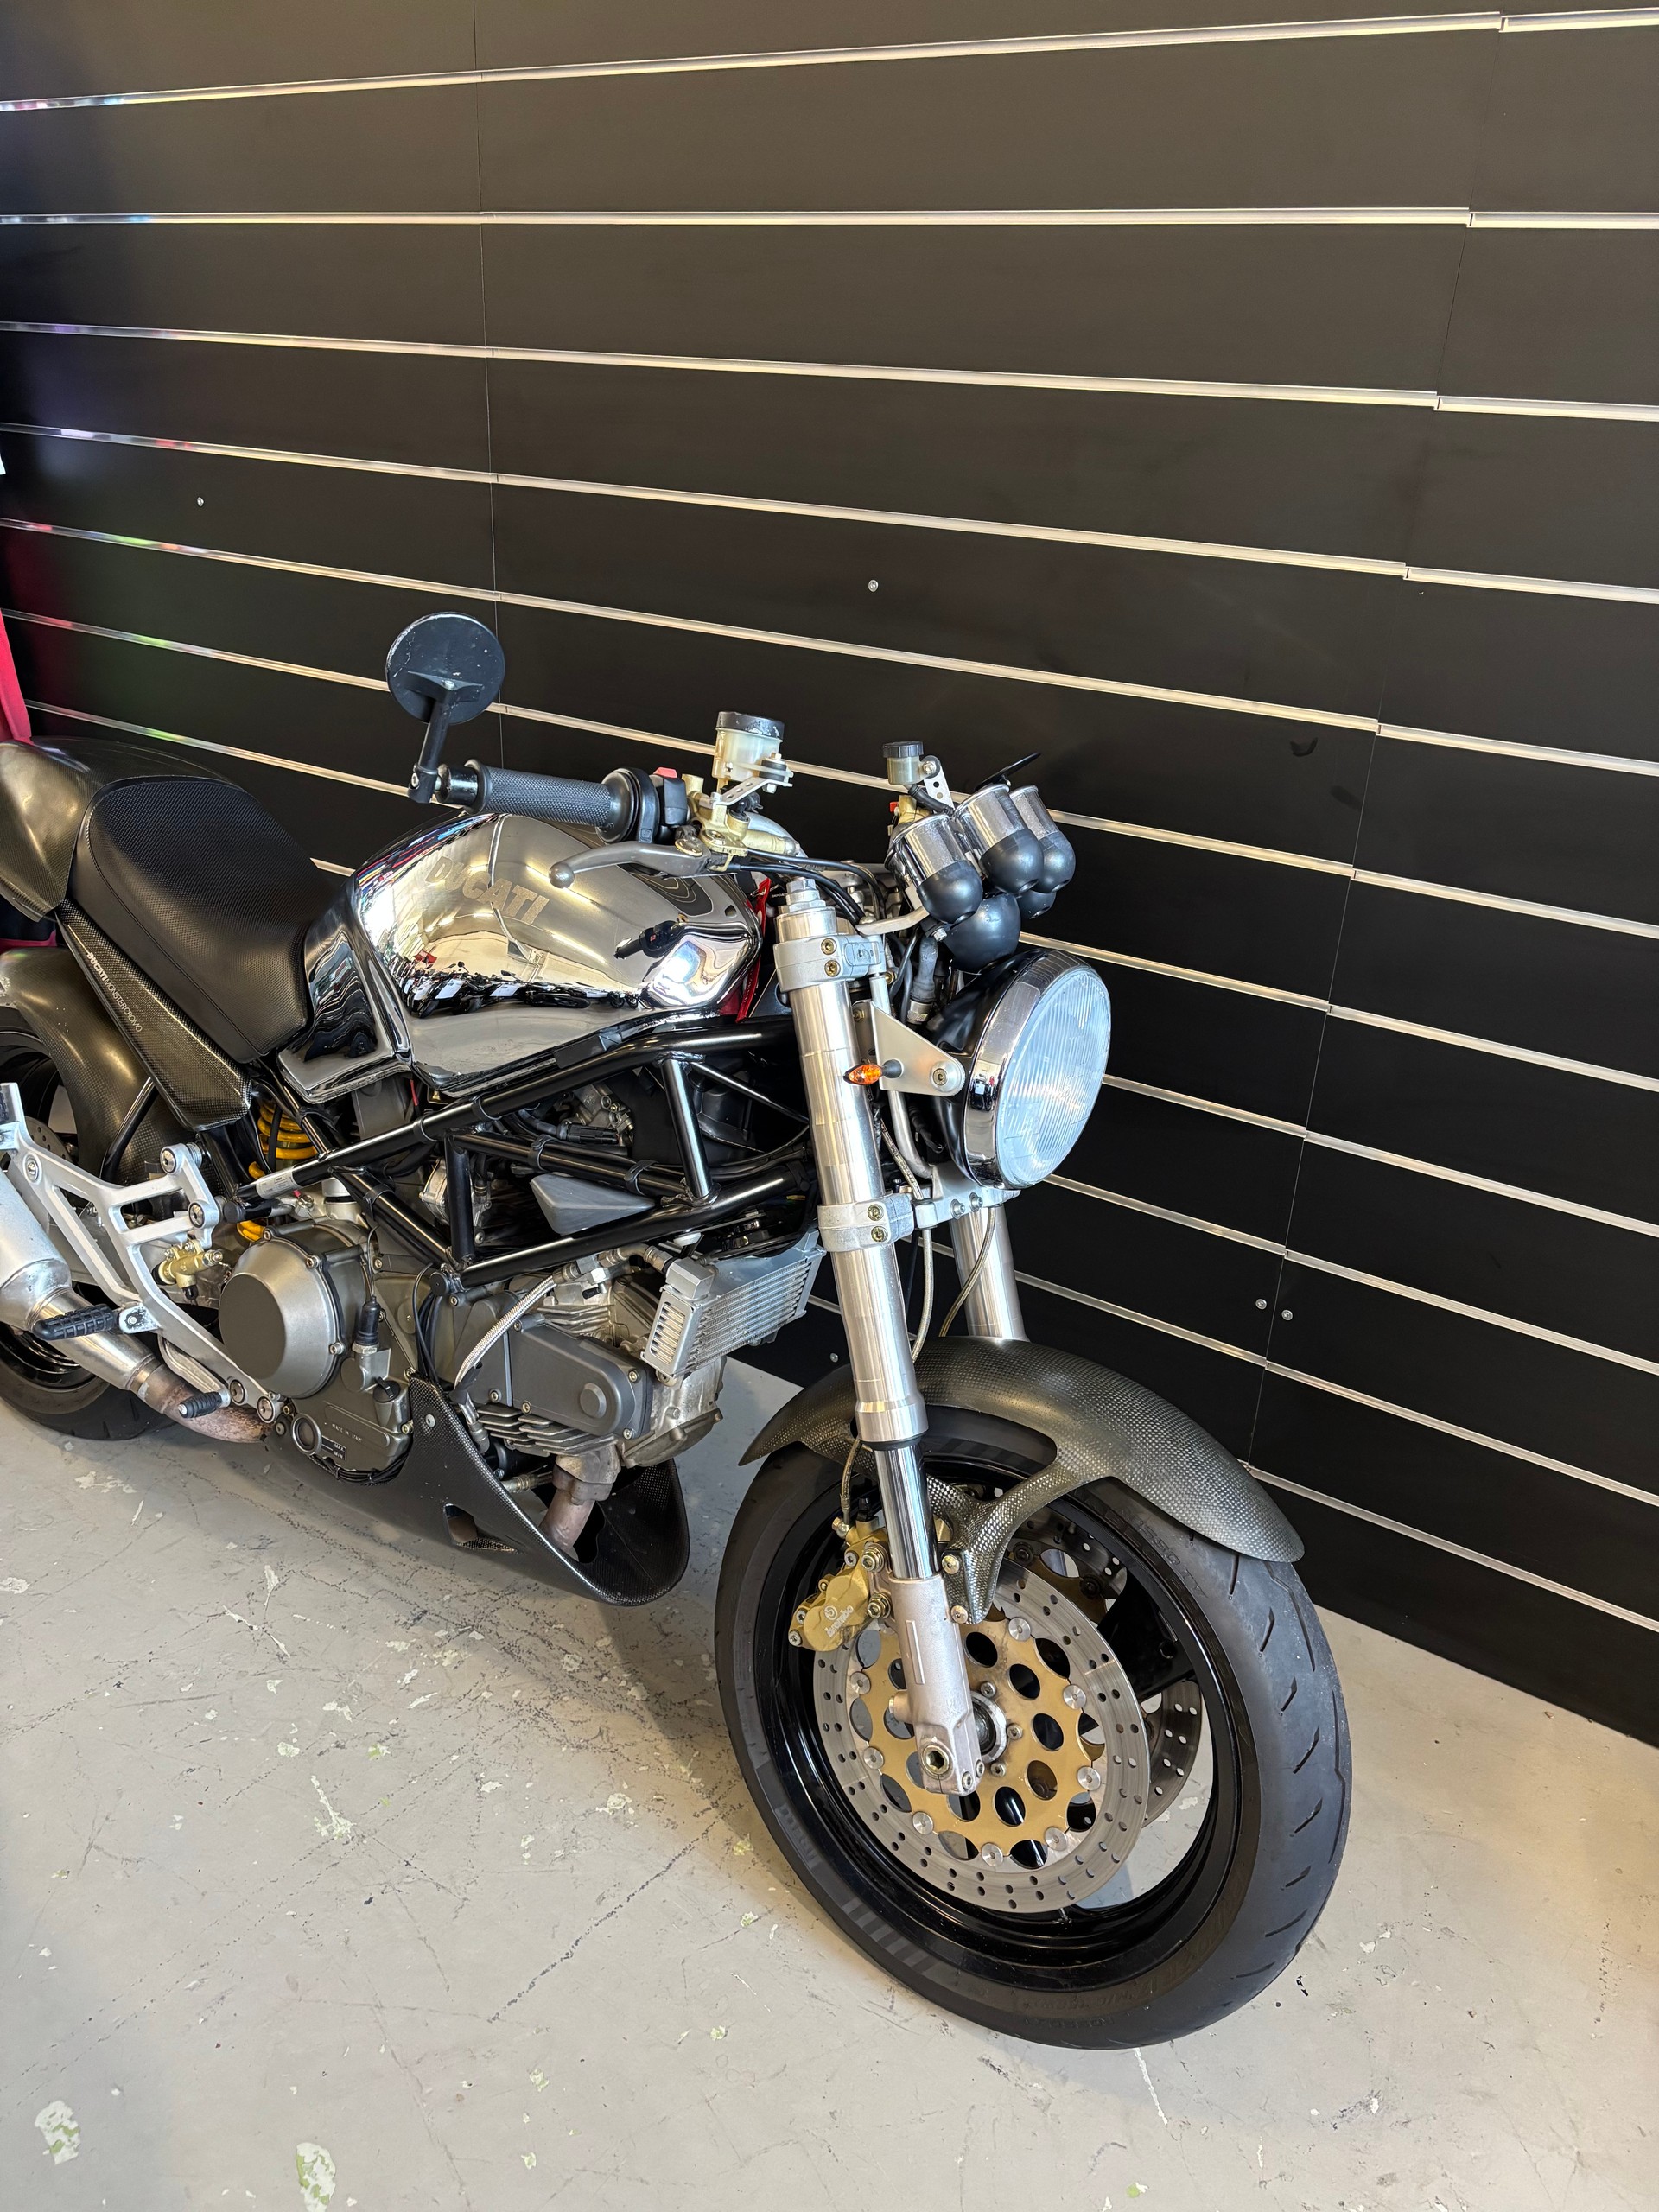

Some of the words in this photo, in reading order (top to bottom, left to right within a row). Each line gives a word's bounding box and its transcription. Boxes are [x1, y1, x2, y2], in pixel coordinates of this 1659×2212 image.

[425, 856, 550, 924] DUCATI
[87, 952, 109, 981] DUCATI
[104, 978, 127, 1010] MONSTER
[124, 1007, 143, 1032] CROMO
[334, 1443, 345, 1452] MAX
[824, 1605, 854, 1637] brembo
